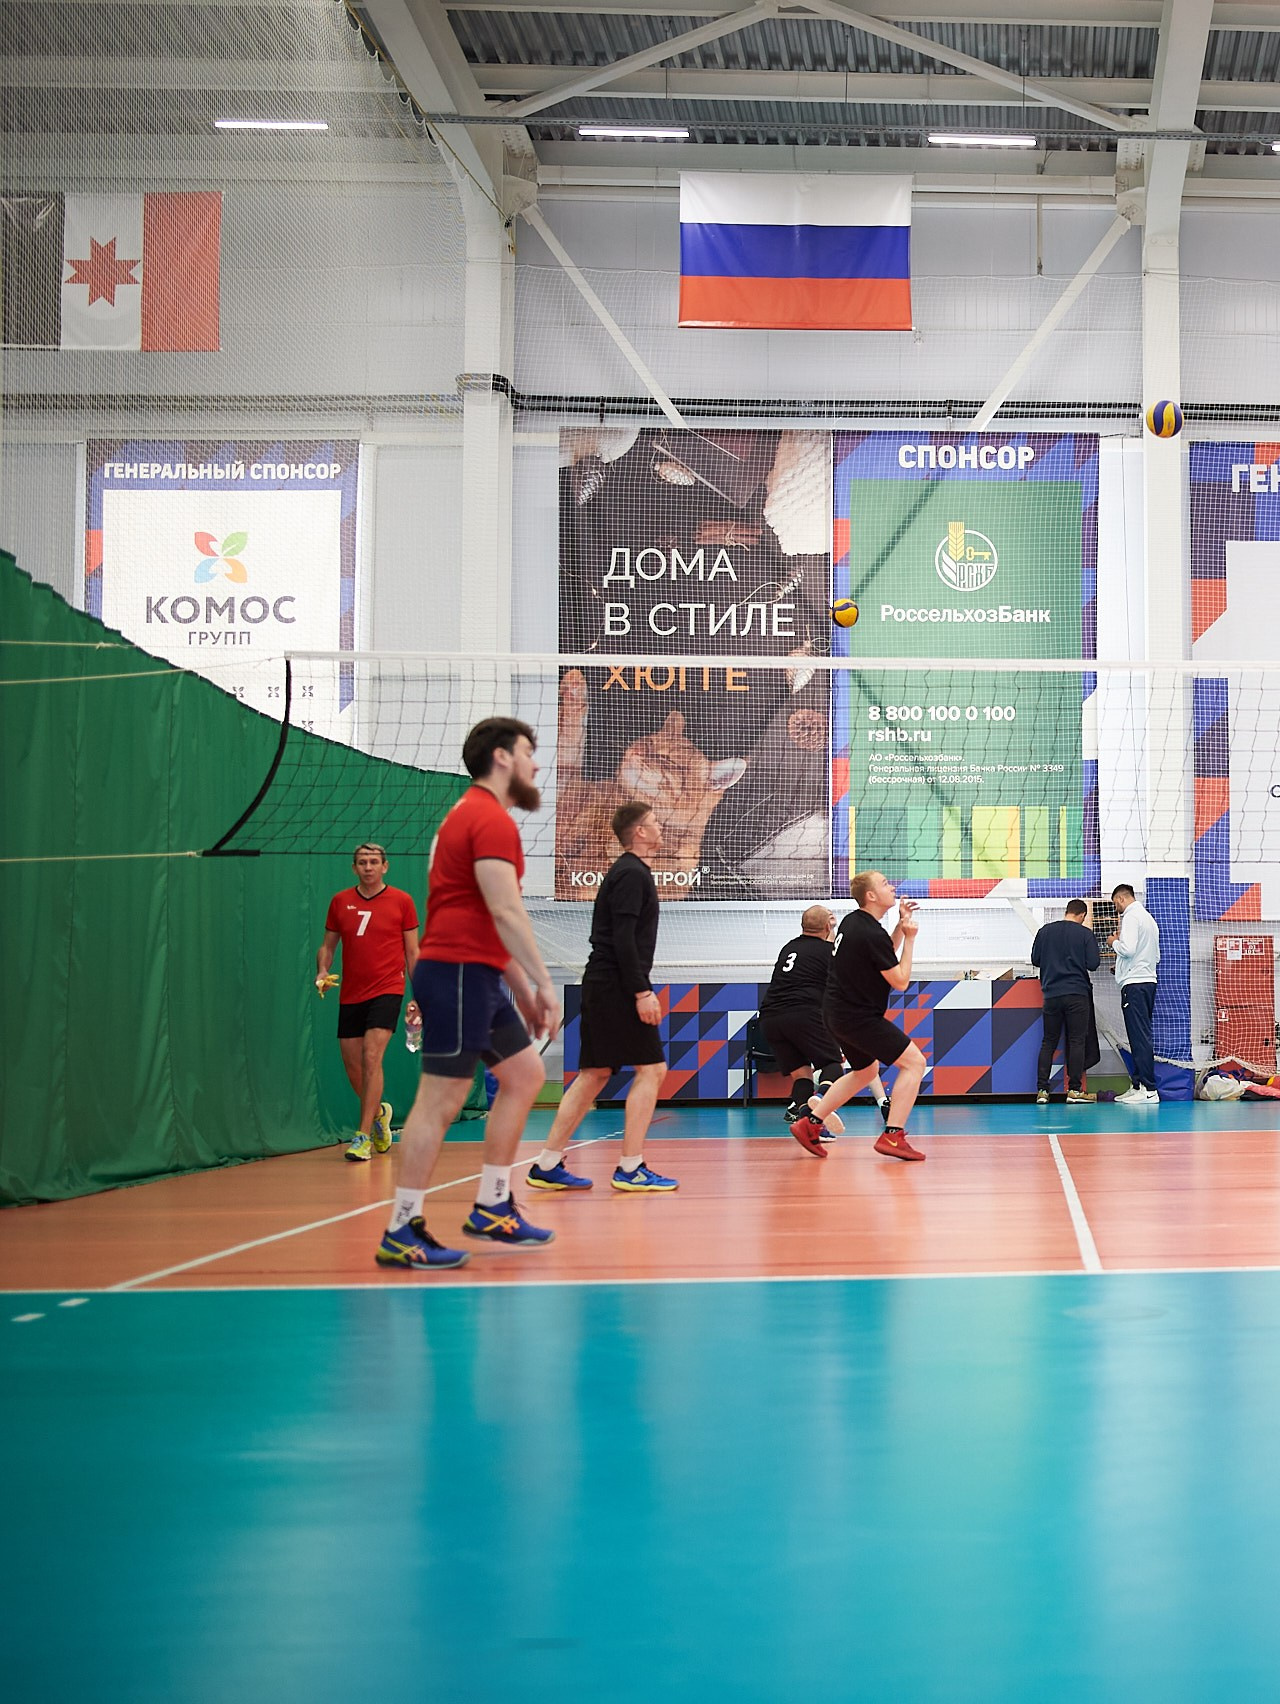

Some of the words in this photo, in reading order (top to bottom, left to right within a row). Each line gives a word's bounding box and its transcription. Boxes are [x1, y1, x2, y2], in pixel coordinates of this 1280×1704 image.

[899, 444, 1035, 469] СПОНСОР
[104, 461, 245, 480] ГЕНЕРАЛЬНЫЙ
[250, 462, 341, 480] СПОНСОР
[603, 547, 738, 589] ДОМА
[146, 596, 297, 624] КОМОС
[604, 602, 631, 636] В
[648, 602, 796, 637] СТИЛЕ
[880, 605, 1051, 623] РоссельхозБанк
[188, 631, 251, 645] ГРУПП
[868, 706, 881, 721] 8
[885, 706, 923, 721] 800
[927, 706, 961, 721] 100
[965, 706, 978, 721] 0
[983, 706, 1016, 721] 100
[868, 727, 932, 742] rshb.ru
[868, 754, 882, 762] АО
[997, 765, 1027, 773] России
[1042, 765, 1064, 773] 3349
[356, 911, 372, 936] 7
[832, 932, 844, 957] 9
[782, 952, 798, 972] 3
